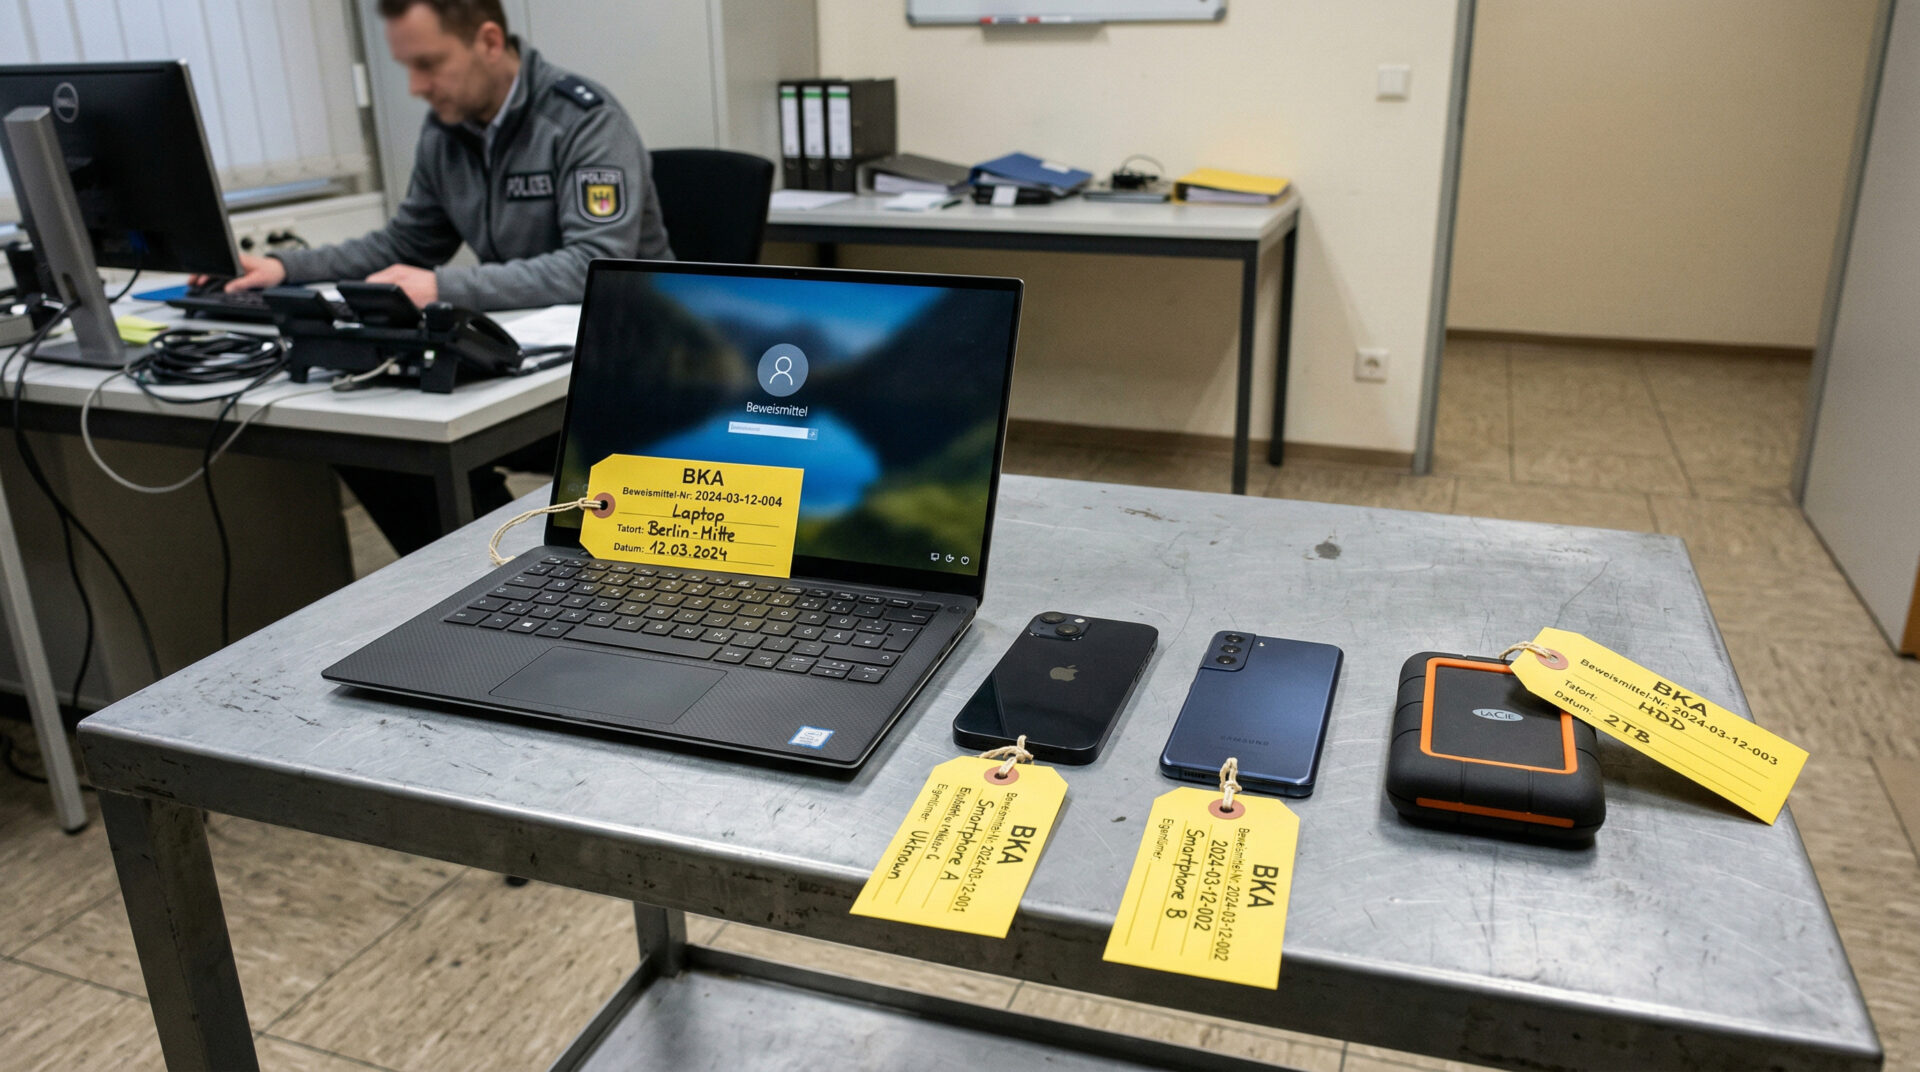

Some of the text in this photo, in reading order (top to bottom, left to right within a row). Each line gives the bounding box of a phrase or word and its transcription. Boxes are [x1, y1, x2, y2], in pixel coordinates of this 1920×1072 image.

[506, 173, 553, 197] POLIZEI
[746, 401, 808, 417] Beweismittel
[682, 467, 724, 487] BKA
[694, 490, 783, 508] 2024-03-12-004
[616, 523, 645, 534] Tatort:
[671, 503, 725, 530] Laptop
[613, 540, 728, 562] Datum: 12.03.2024
[1565, 679, 1598, 701] Tatort:
[1652, 680, 1707, 718] BKA
[1554, 690, 1650, 744] Datum: 2TB
[1638, 701, 1686, 731] HDD
[1671, 706, 1778, 766] 2024-03-12-003
[948, 799, 995, 866] Smartphone
[996, 824, 1037, 865] BKA
[940, 870, 960, 880] A
[952, 845, 995, 913] 2024-03-12-001
[1165, 828, 1205, 919] Smartphone B
[1193, 839, 1229, 932] 2024-03-12-002
[1247, 864, 1279, 908] BKA
[1213, 885, 1241, 962] 2024-03-12-002
